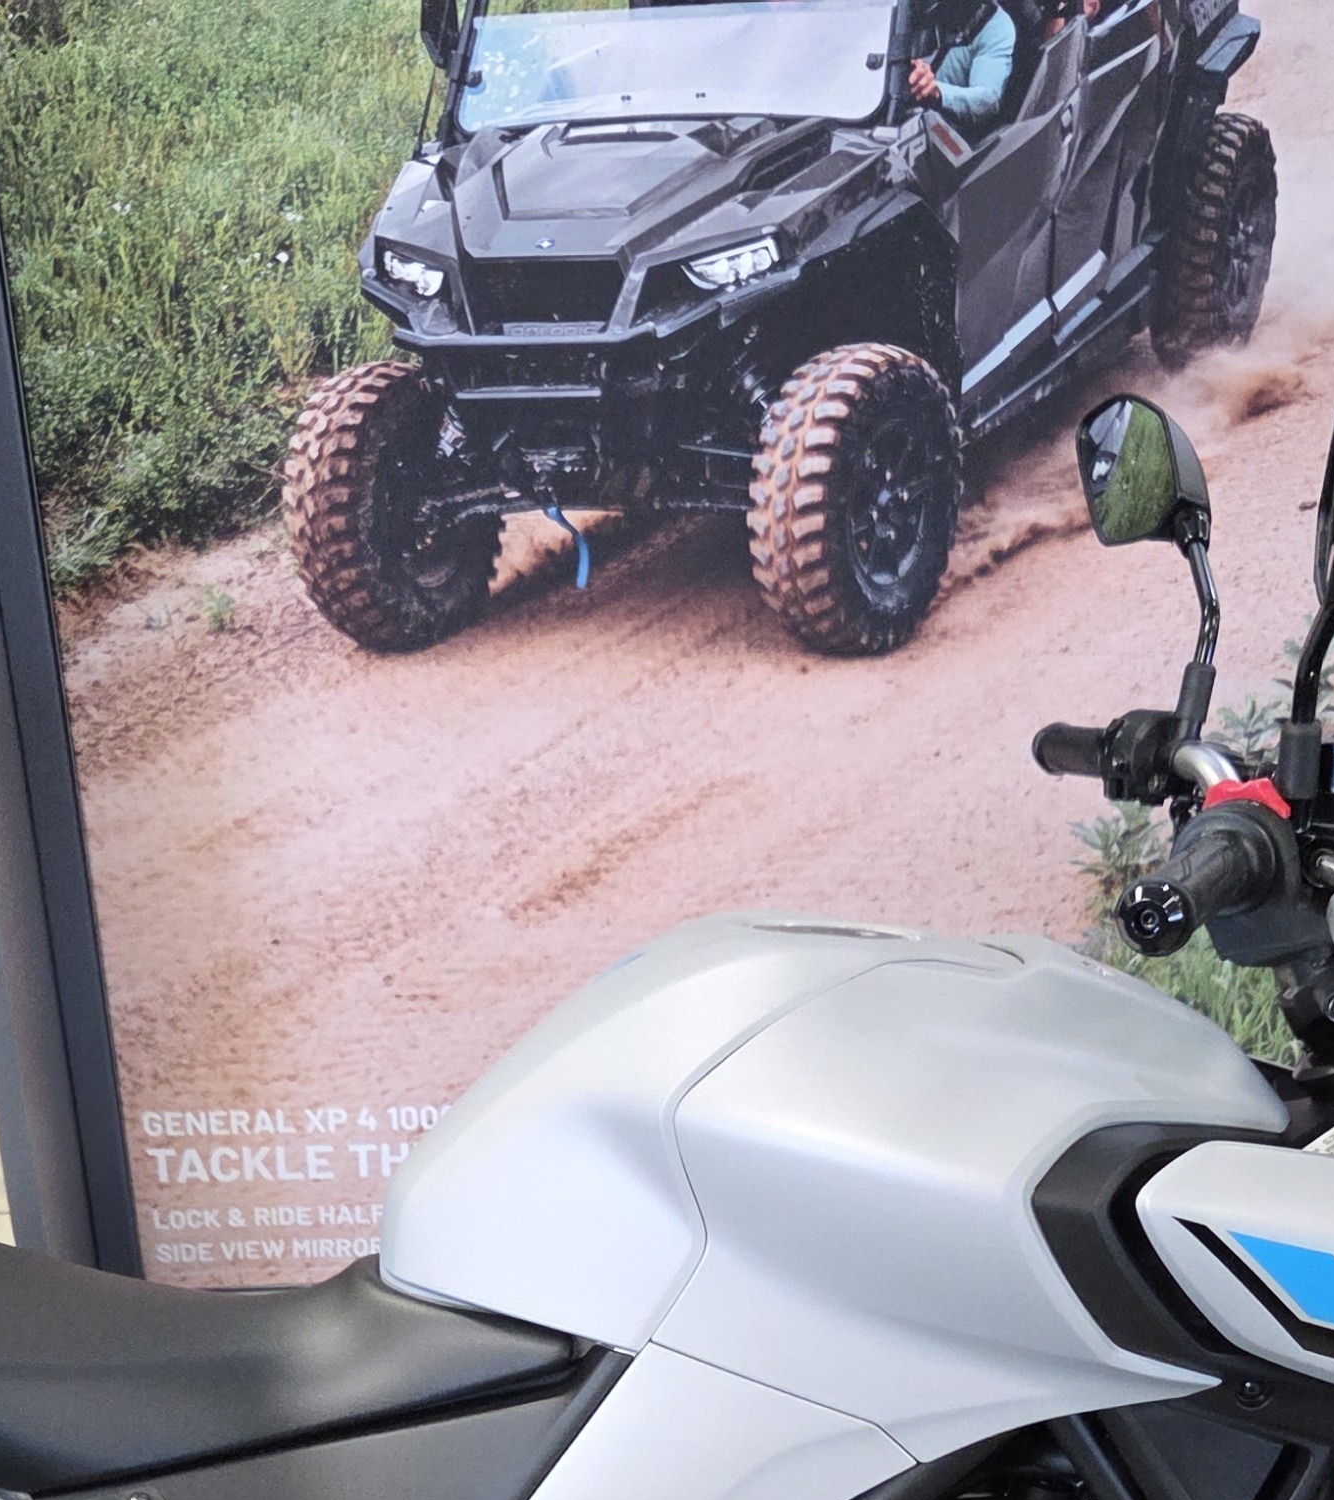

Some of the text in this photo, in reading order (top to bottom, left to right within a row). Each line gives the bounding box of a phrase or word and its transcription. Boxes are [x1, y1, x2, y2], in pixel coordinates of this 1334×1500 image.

[142, 1110, 296, 1137] GENERAL
[305, 1108, 349, 1135] XP
[357, 1106, 378, 1132] 4
[145, 1142, 418, 1184] TACKLE TH
[152, 1207, 221, 1231] LOCK
[227, 1206, 246, 1228] &
[254, 1206, 313, 1227] RIDE
[155, 1242, 214, 1264] SIDE
[219, 1238, 287, 1261] VIEW
